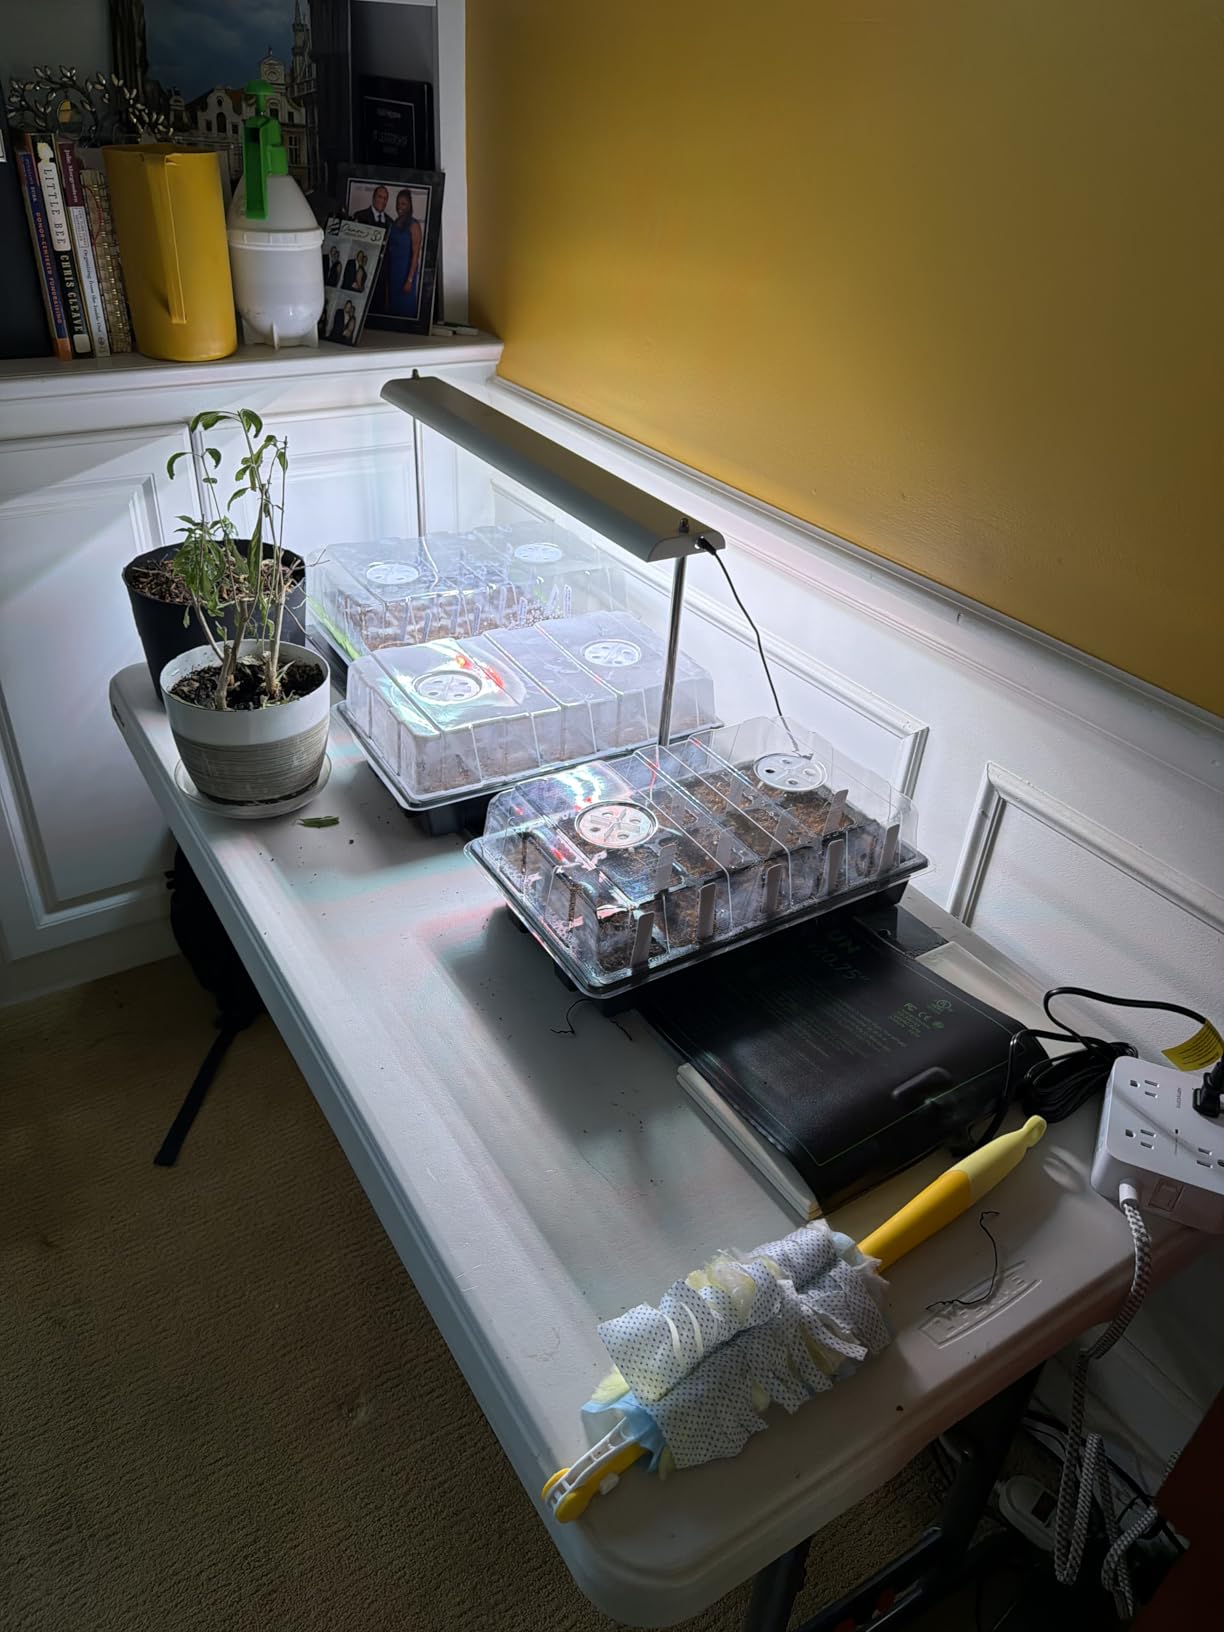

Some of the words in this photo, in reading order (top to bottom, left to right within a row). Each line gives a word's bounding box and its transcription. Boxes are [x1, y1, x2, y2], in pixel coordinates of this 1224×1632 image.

[43, 169, 60, 215] LITTLE
[54, 223, 65, 245] BEE
[60, 254, 74, 288] CHRIS
[67, 292, 82, 332] CLEAVE
